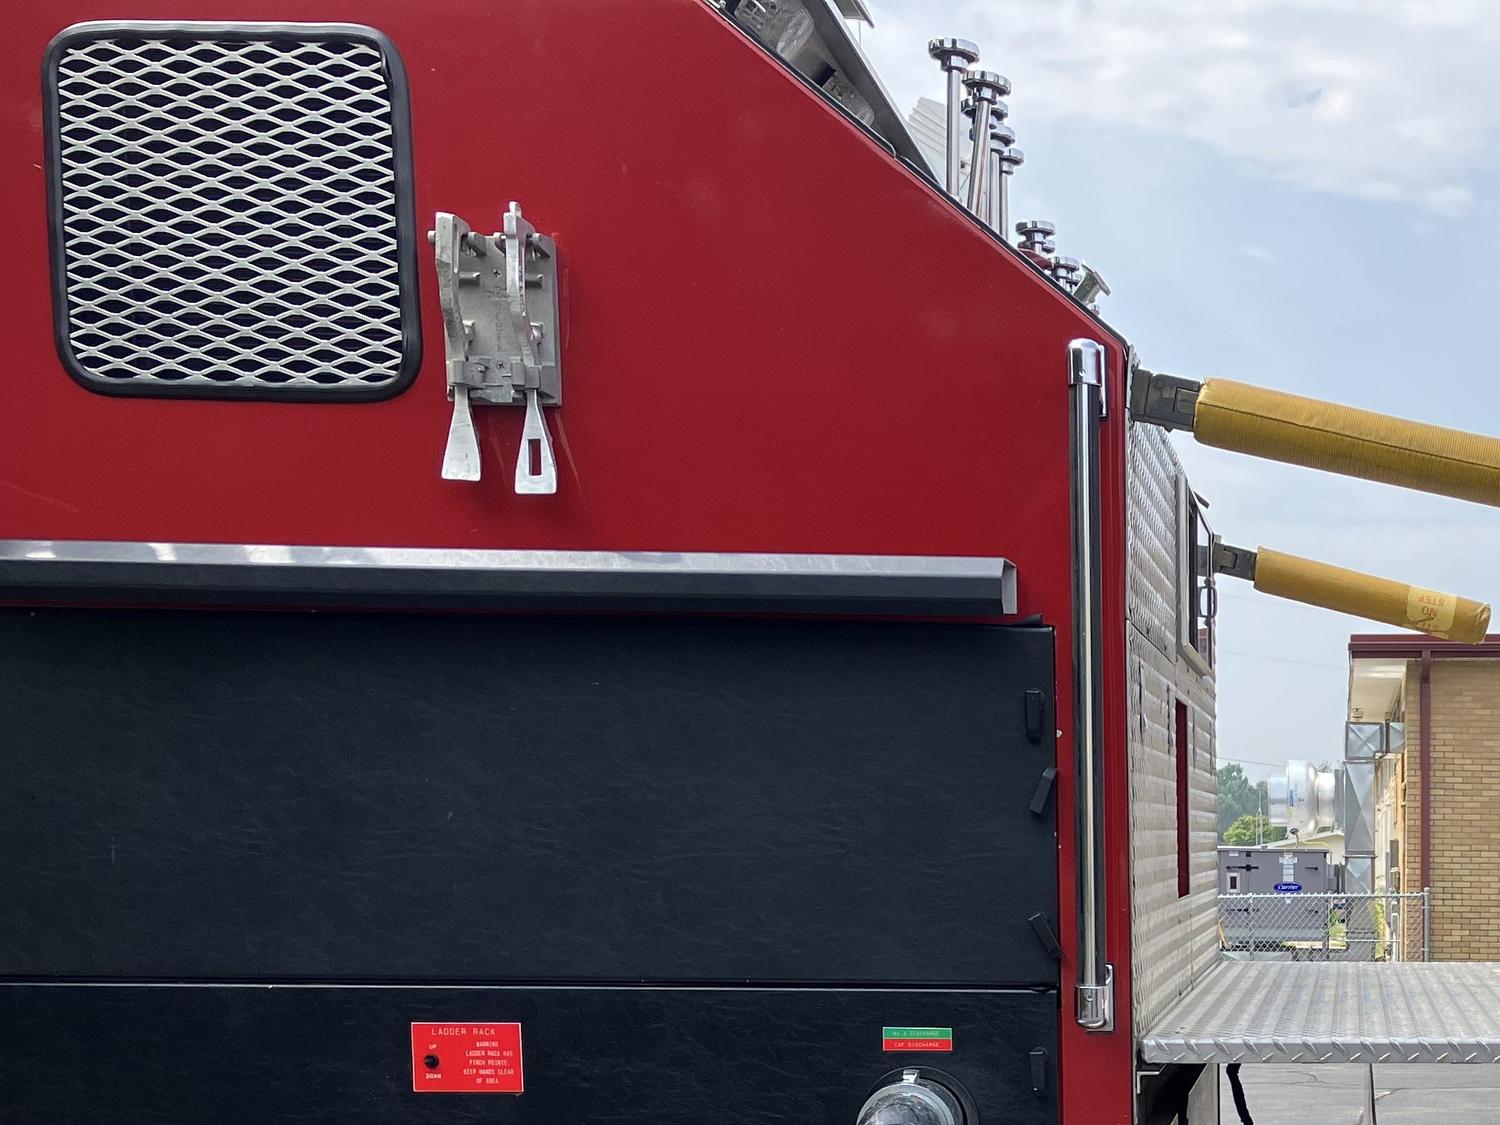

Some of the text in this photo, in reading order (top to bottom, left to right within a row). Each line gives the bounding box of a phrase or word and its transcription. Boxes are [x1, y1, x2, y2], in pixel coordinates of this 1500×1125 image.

[1417, 595, 1446, 607] STEP
[431, 1028, 496, 1036] LADDER RACK
